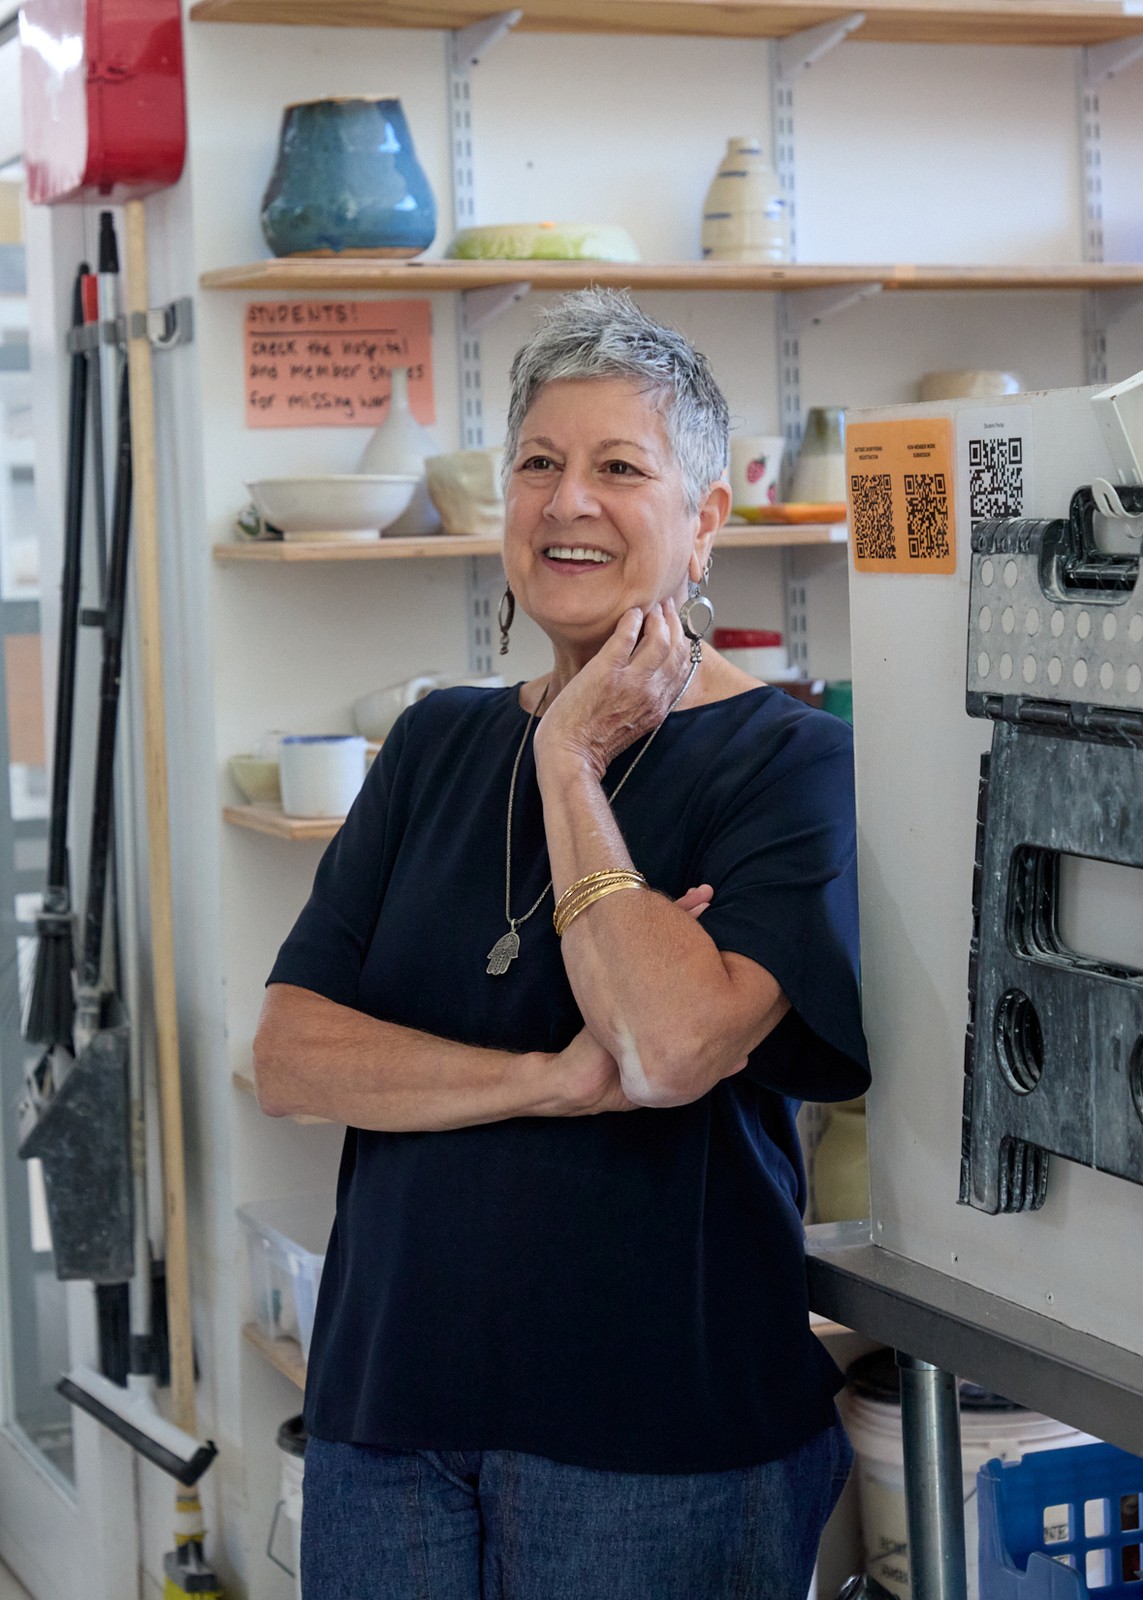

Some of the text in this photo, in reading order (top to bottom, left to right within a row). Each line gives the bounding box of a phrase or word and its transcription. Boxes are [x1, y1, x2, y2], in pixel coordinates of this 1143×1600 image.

[248, 302, 358, 324] STUDENTS!
[307, 341, 331, 357] the
[290, 363, 361, 380] member
[250, 390, 392, 417] for missing wor
